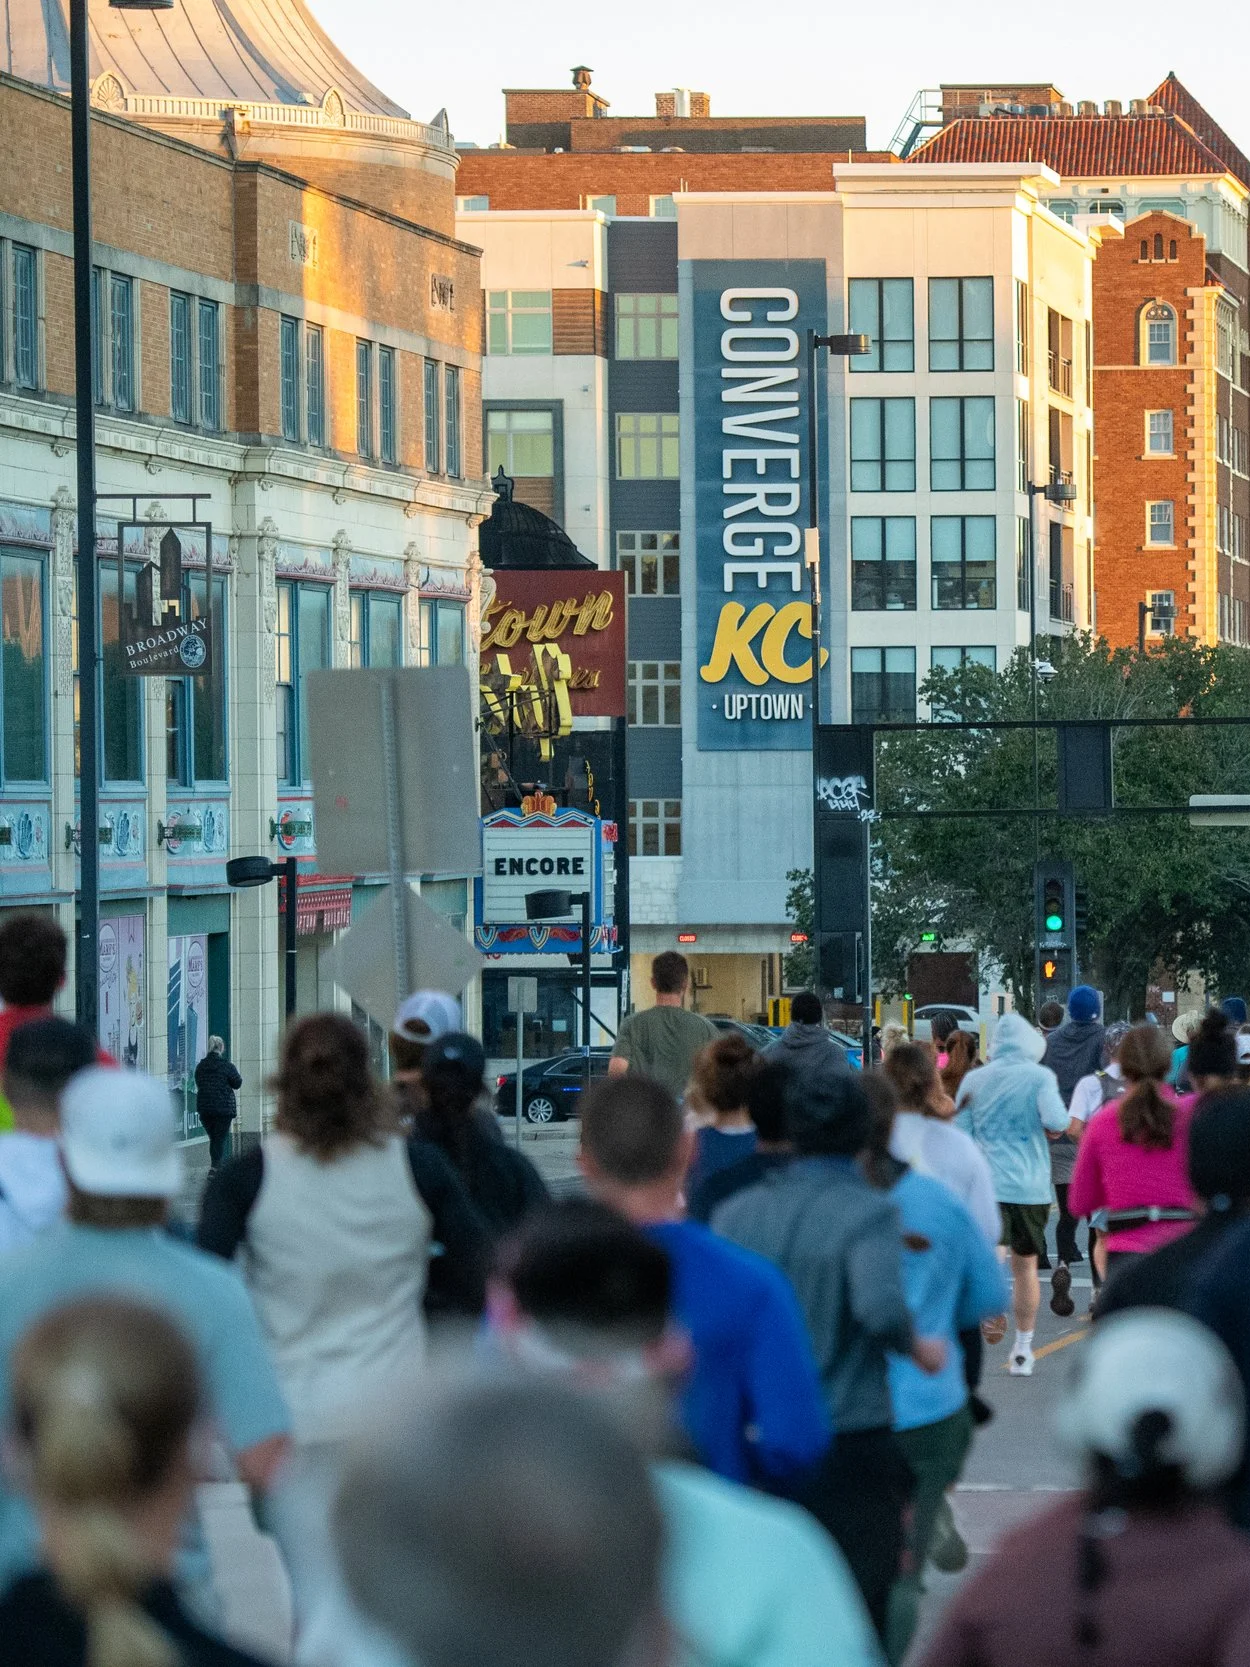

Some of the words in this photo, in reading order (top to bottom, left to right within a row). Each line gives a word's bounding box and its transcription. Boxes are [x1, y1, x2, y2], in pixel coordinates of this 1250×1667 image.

[720, 287, 801, 592] CONVERGE
[126, 618, 207, 656] BROADWAY
[700, 601, 829, 686] KC
[129, 645, 179, 668] Boulevard
[724, 694, 803, 720] UPTOWN
[494, 857, 585, 876] ENCORE
